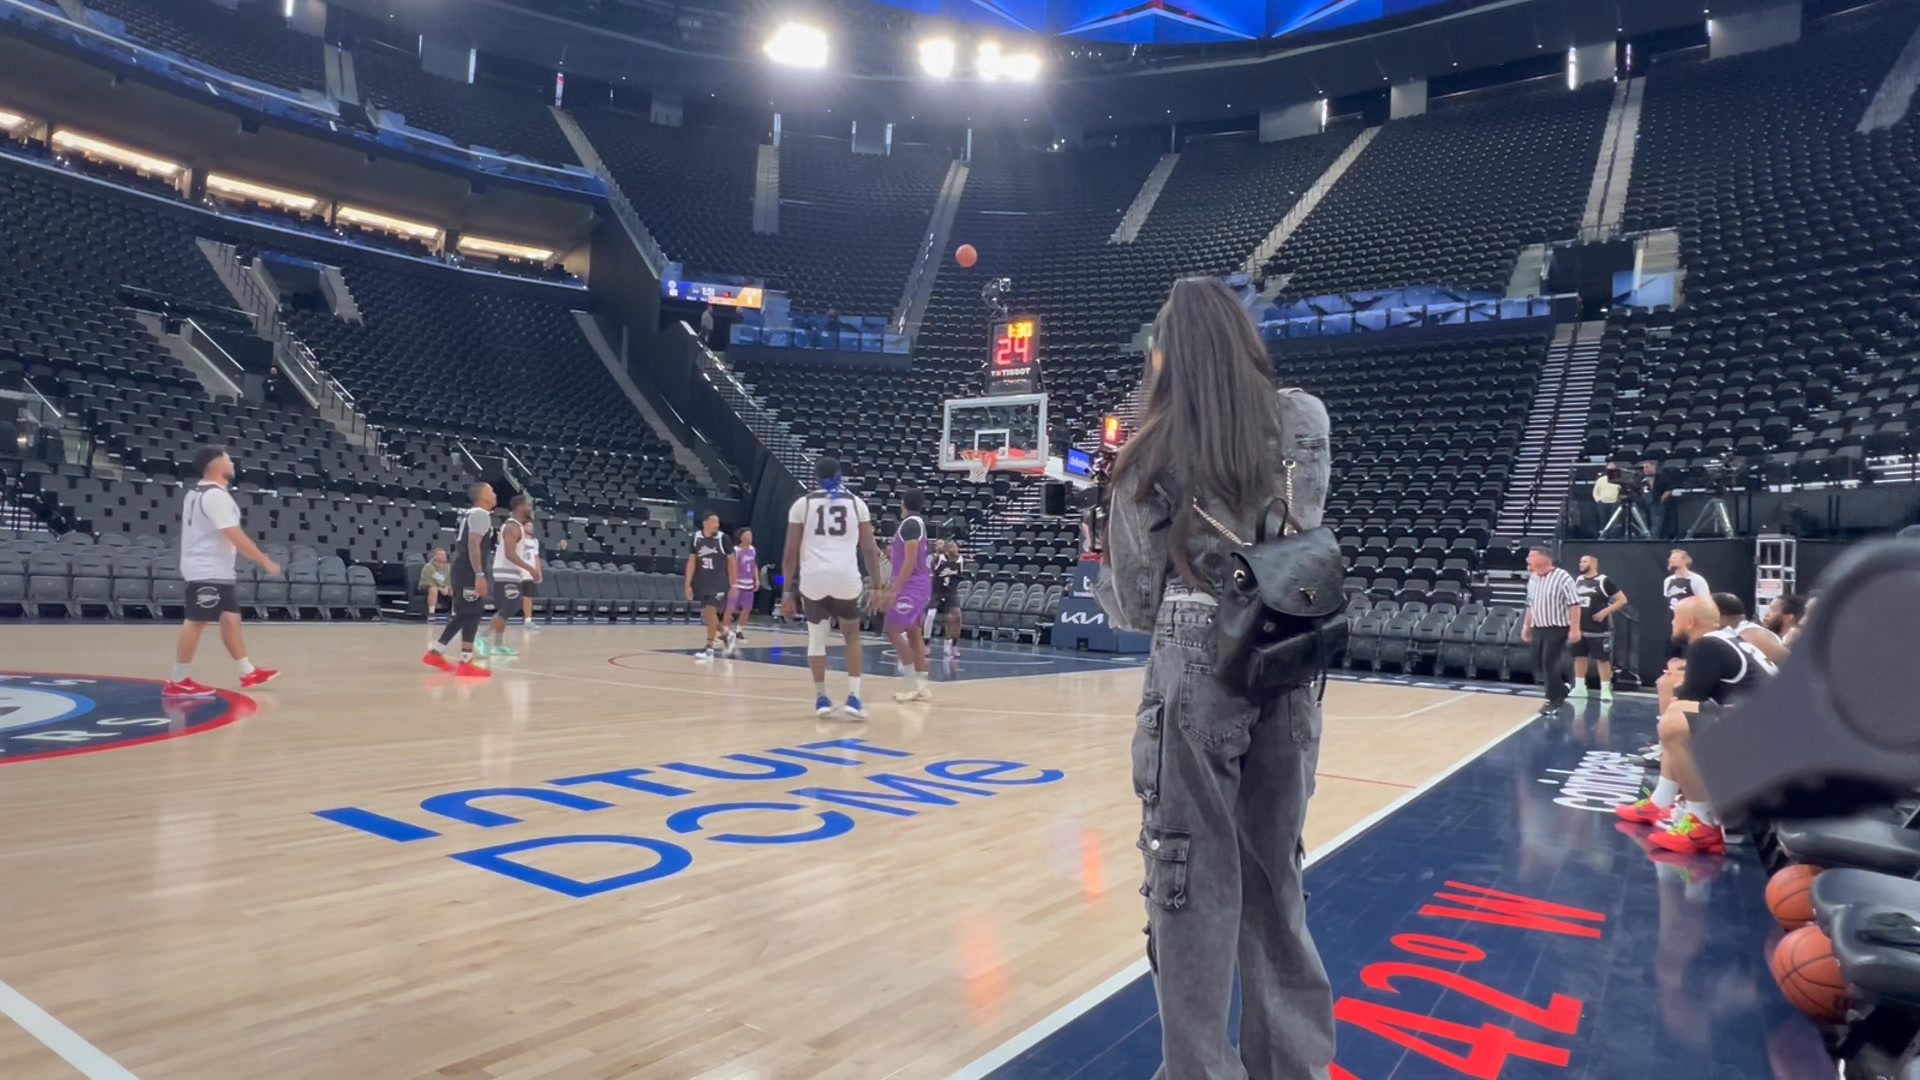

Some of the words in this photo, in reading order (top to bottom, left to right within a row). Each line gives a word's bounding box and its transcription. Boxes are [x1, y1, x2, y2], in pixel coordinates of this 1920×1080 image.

[1008, 322, 1032, 338] 1:30
[997, 338, 1029, 365] 24
[814, 505, 848, 536] 13
[701, 557, 713, 569] 31
[1061, 611, 1104, 625] KIA
